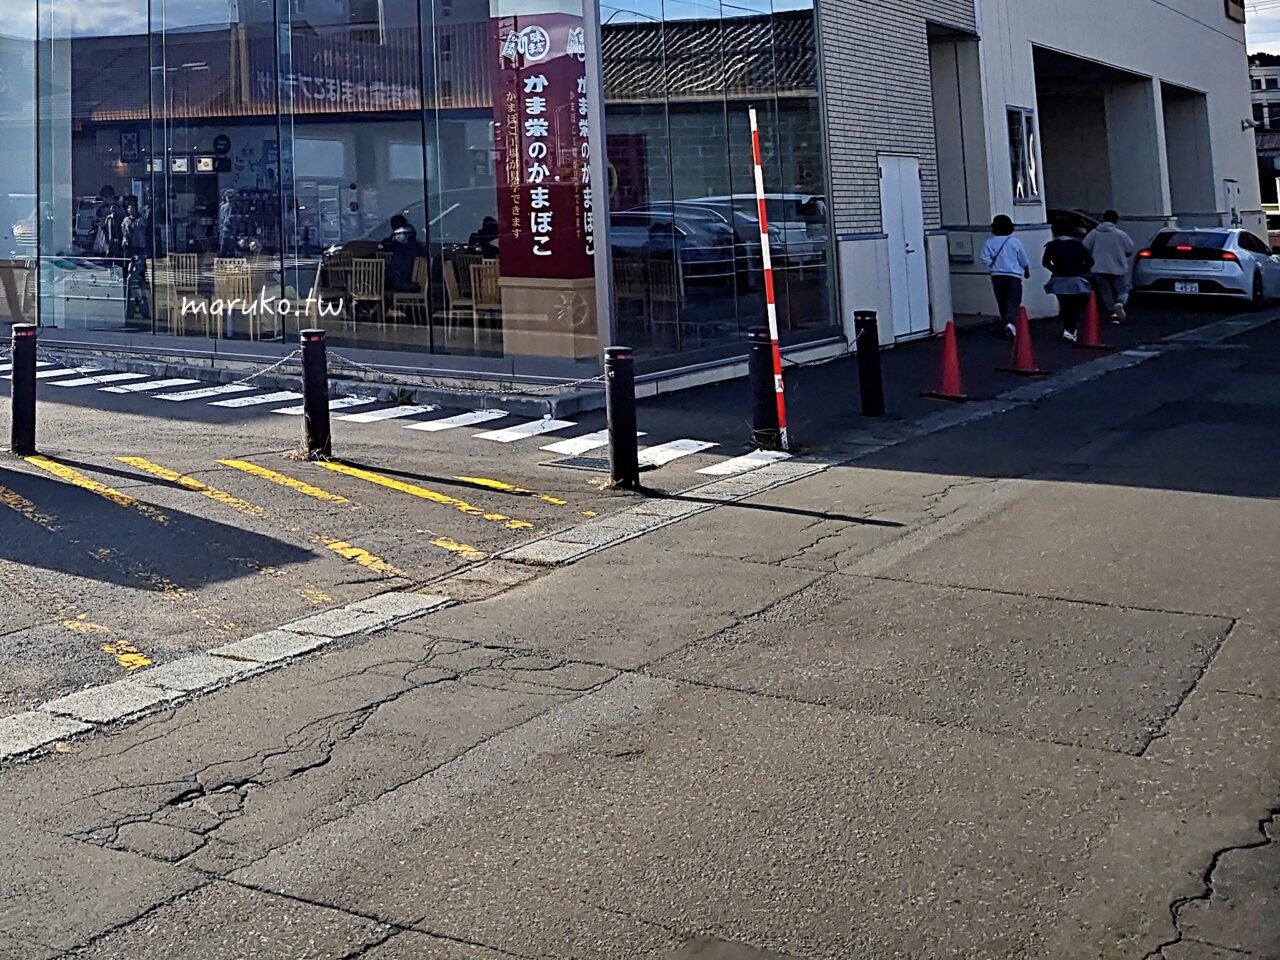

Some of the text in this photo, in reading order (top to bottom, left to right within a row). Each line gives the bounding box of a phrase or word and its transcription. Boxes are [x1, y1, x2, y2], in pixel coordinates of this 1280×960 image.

[523, 74, 553, 256] かま栄のかまぼこ
